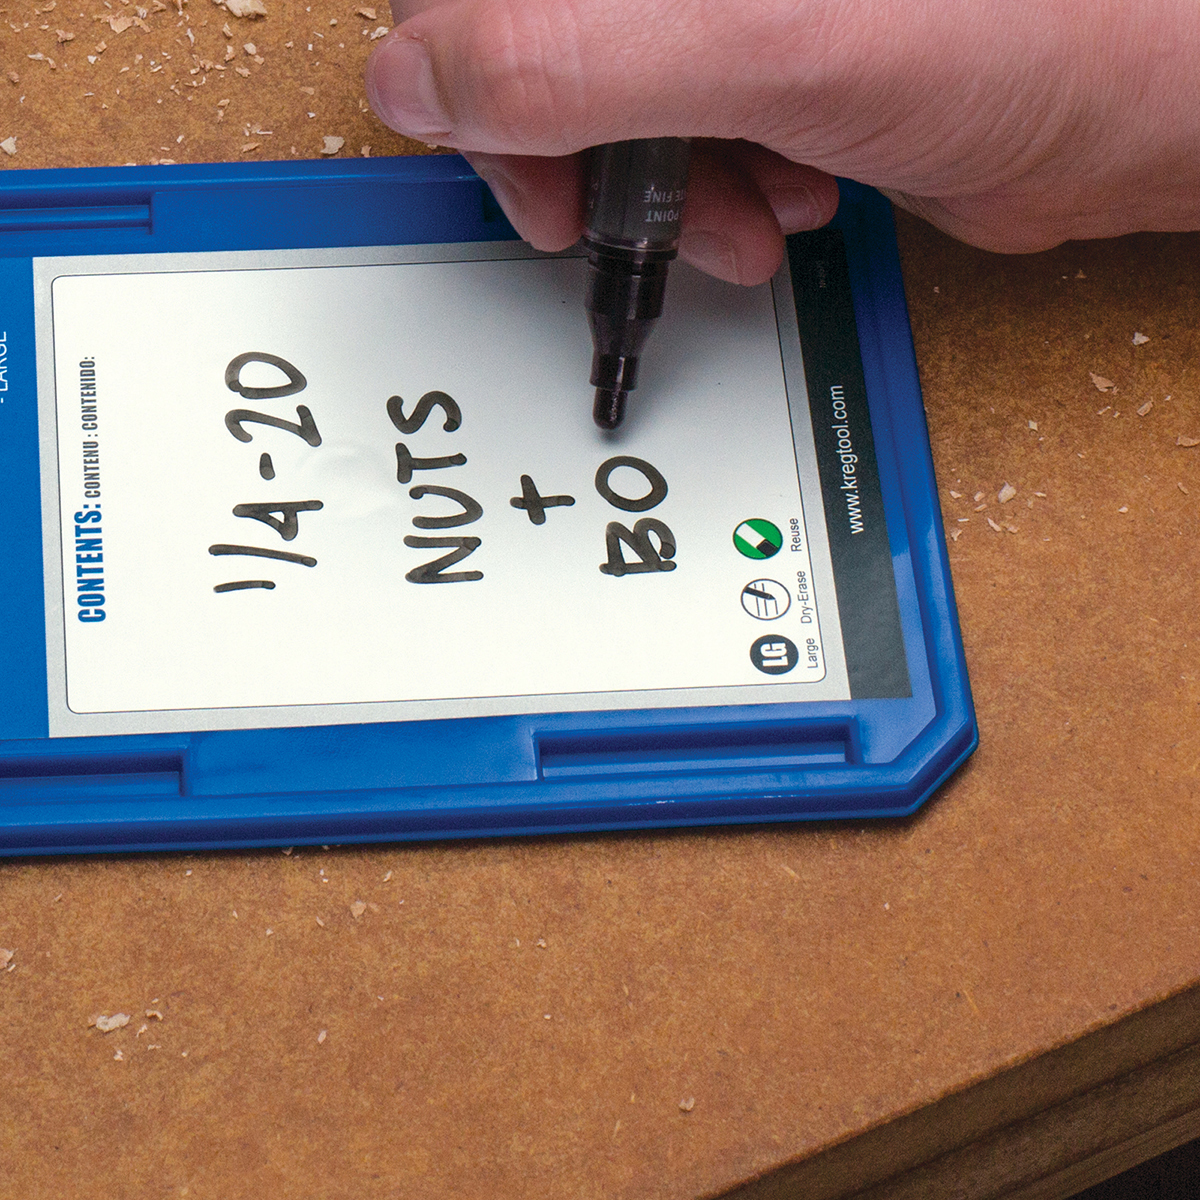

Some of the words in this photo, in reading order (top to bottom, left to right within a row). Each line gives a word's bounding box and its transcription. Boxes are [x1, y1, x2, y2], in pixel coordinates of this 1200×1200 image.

[645, 209, 679, 223] POINT
[78, 355, 98, 431] CONTENIDO:
[386, 390, 484, 584] NUTS
[829, 384, 865, 535] www.kregtool.com
[594, 455, 677, 577] BO
[789, 517, 803, 552] Reuse
[73, 503, 107, 623] CONTENTS:
[796, 570, 813, 624] Dry-Erase
[760, 642, 789, 667] LG
[805, 637, 819, 669] Large
